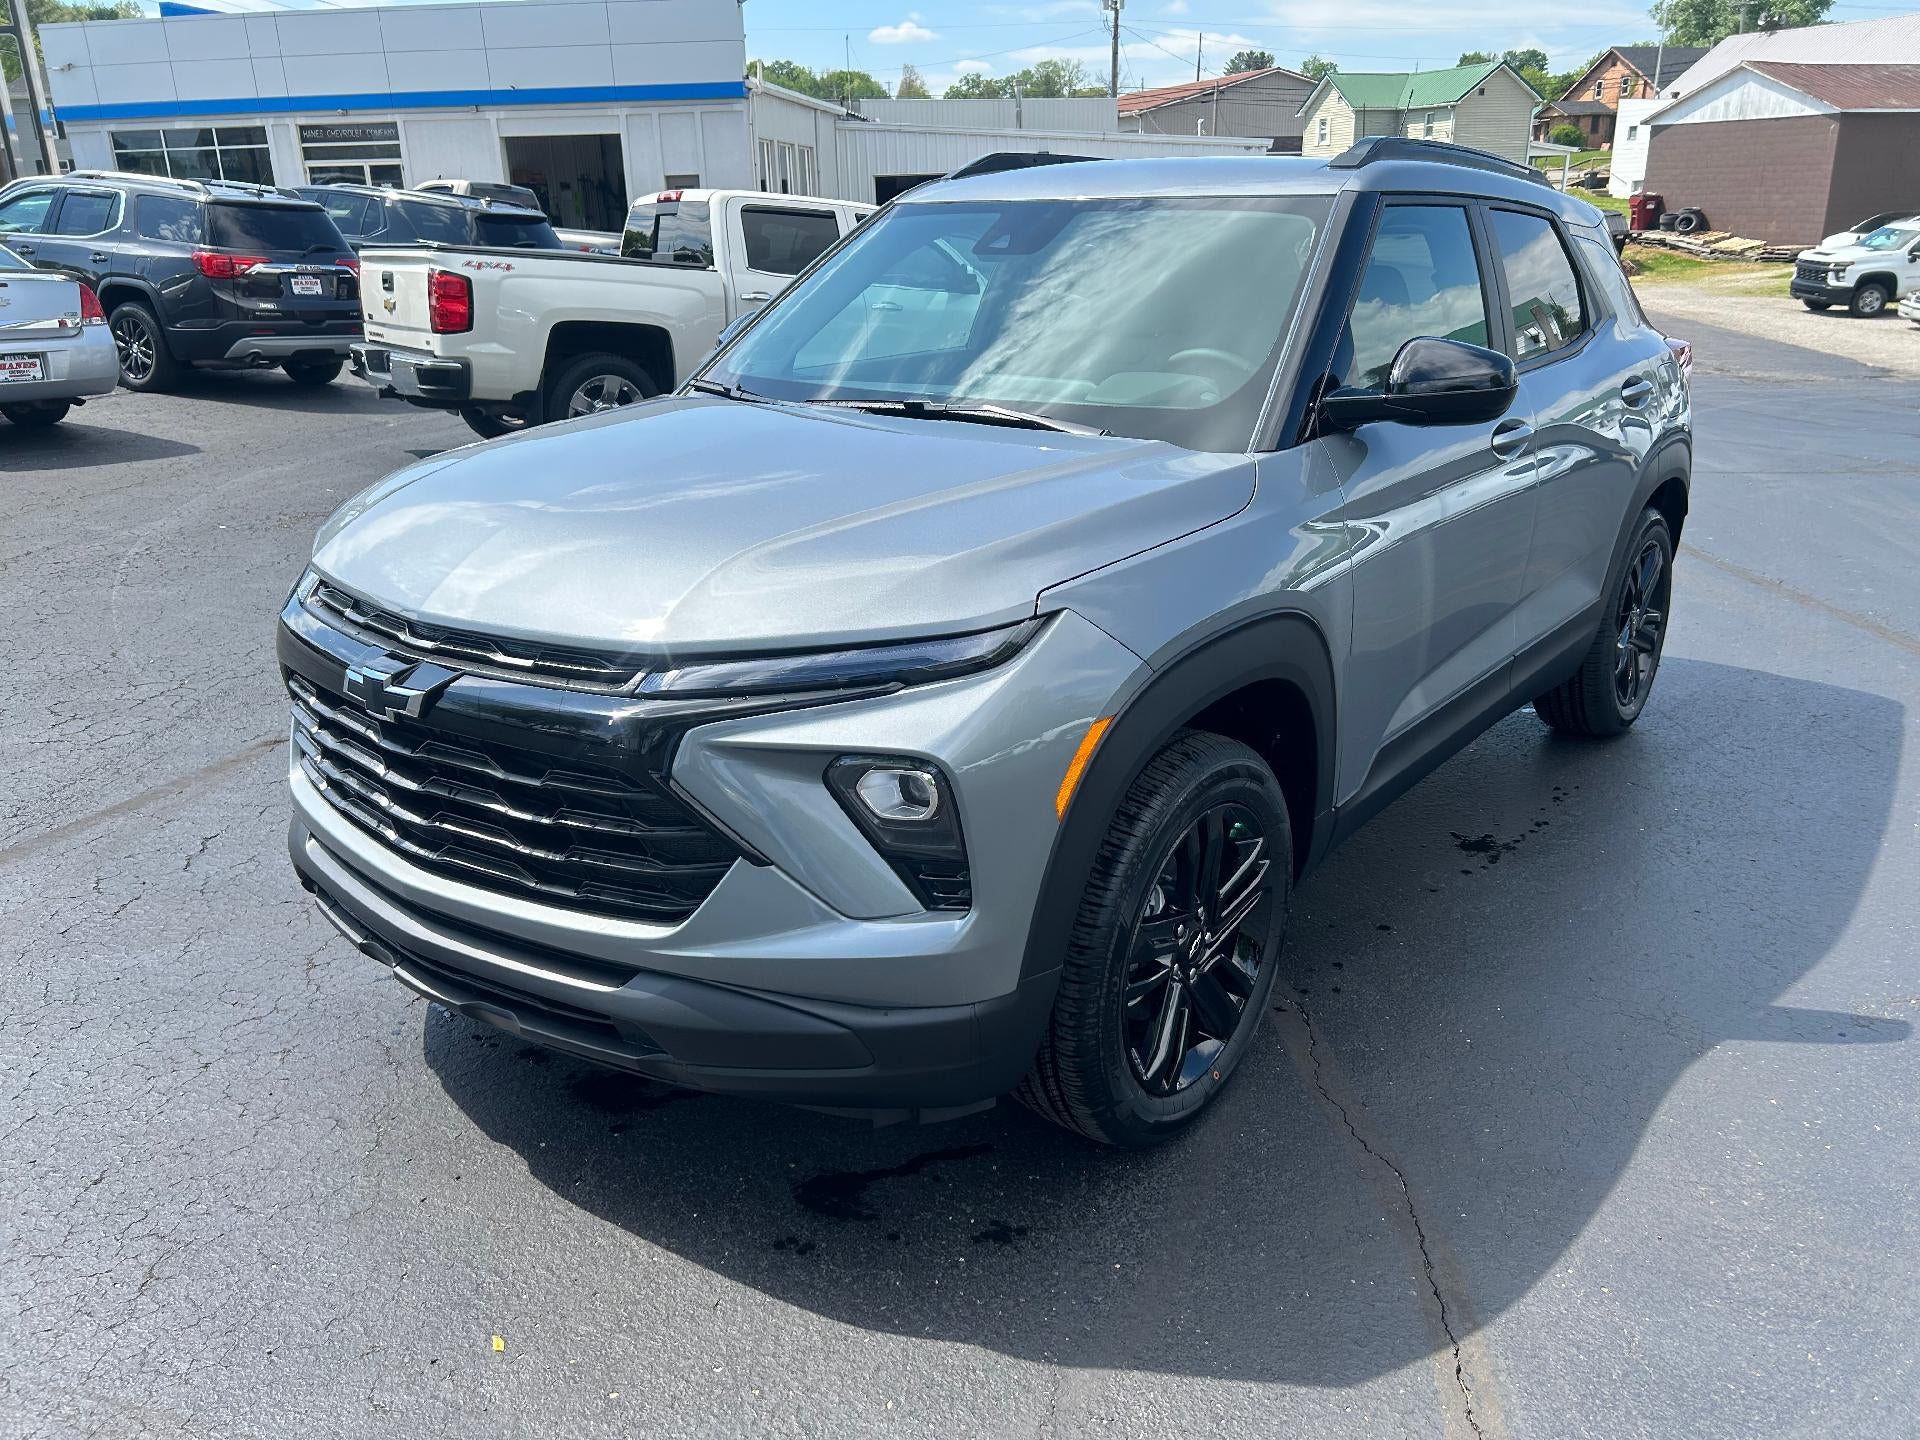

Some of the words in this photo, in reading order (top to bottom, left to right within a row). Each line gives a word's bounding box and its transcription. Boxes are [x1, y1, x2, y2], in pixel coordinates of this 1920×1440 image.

[302, 129, 323, 139] HANES
[326, 129, 362, 138] CHEVROLET
[366, 128, 396, 138] COMPANY
